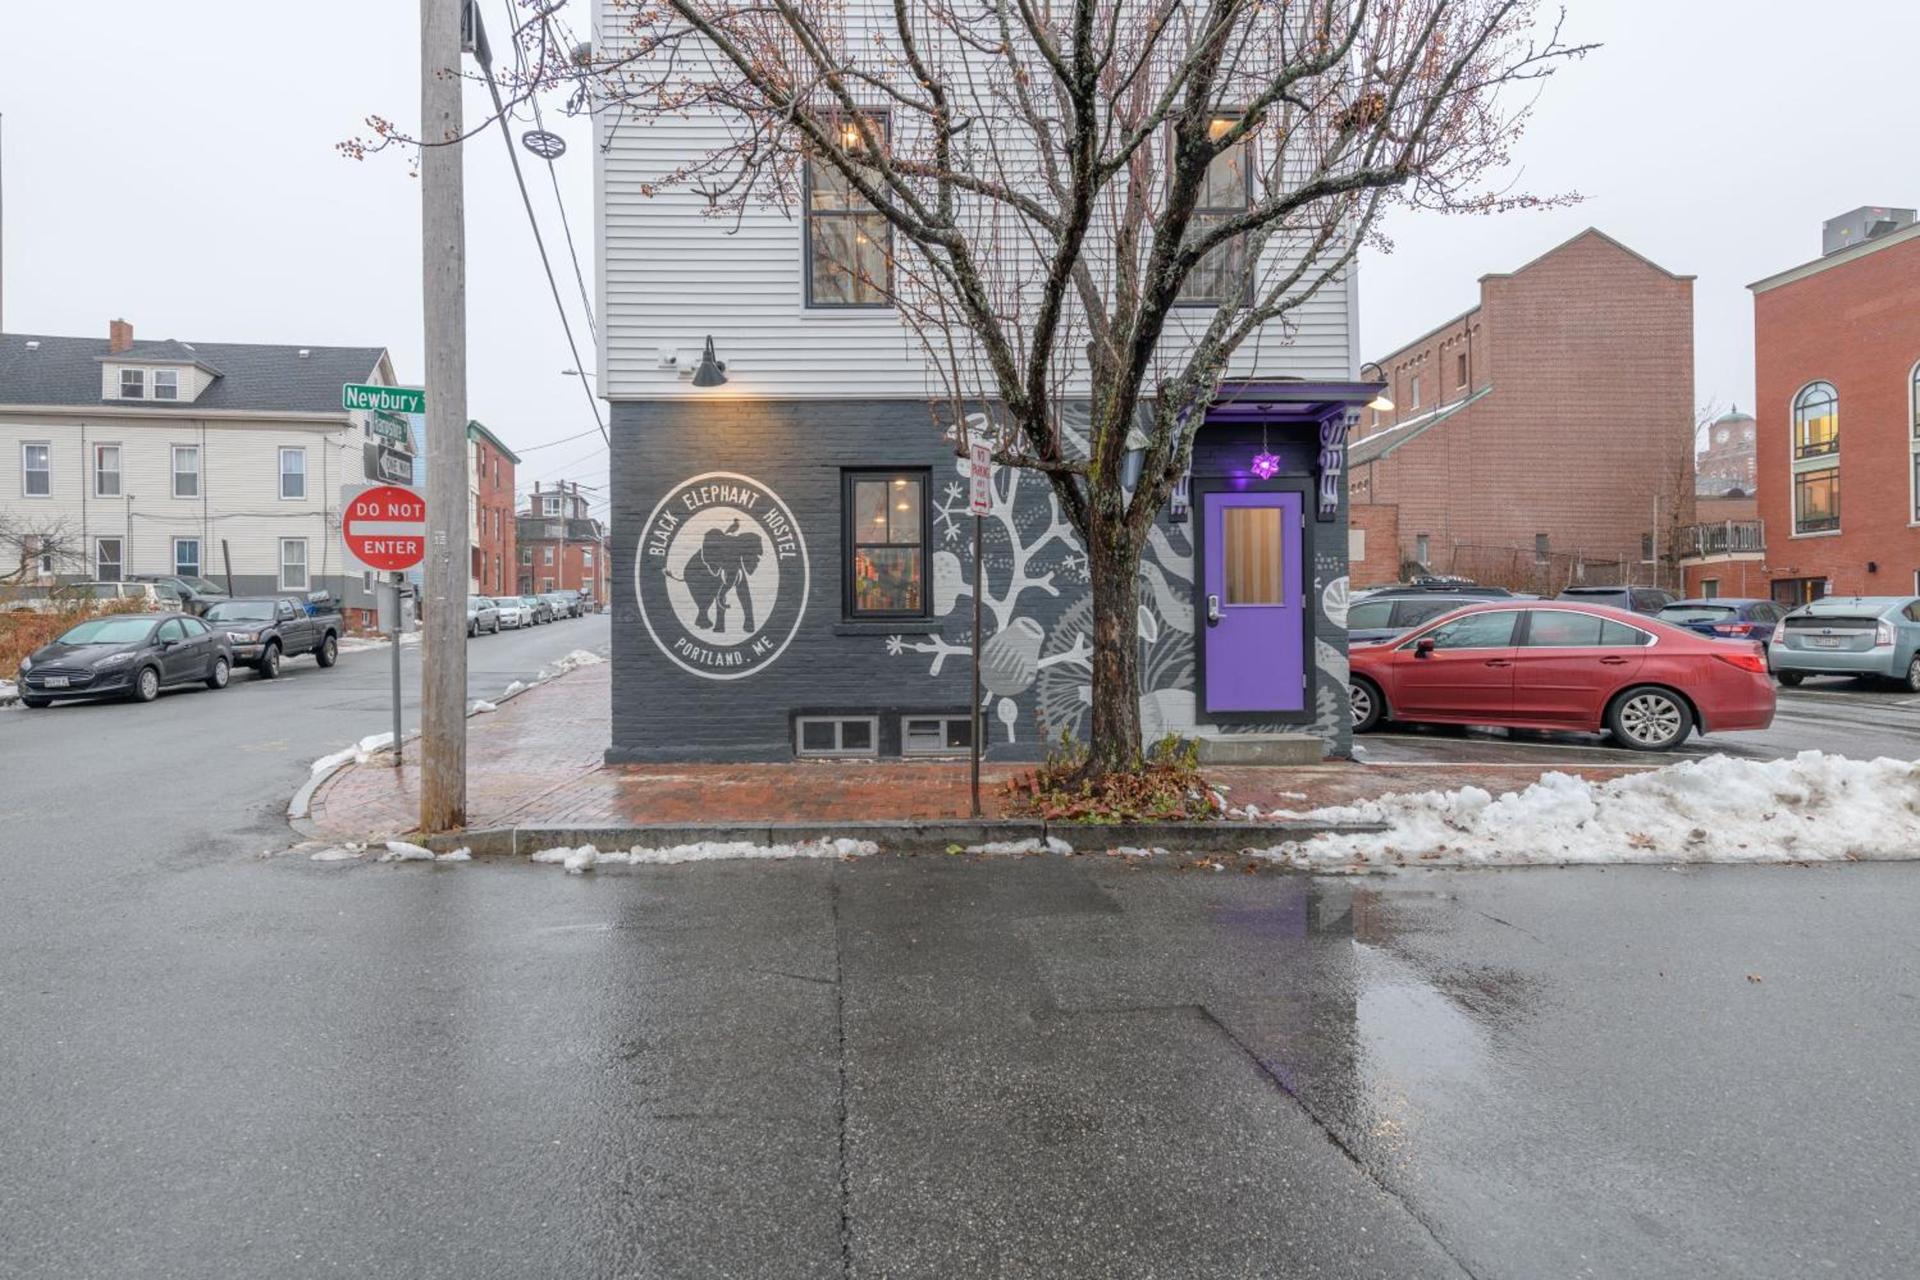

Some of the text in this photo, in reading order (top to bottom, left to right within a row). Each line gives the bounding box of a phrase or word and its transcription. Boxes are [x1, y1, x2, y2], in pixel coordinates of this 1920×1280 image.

[346, 387, 418, 412] Newbury
[356, 503, 422, 518] DO NOT
[650, 485, 797, 560] BLACK ELEPHANT HOSTEL
[363, 540, 417, 555] ENTER
[752, 635, 774, 656] ME
